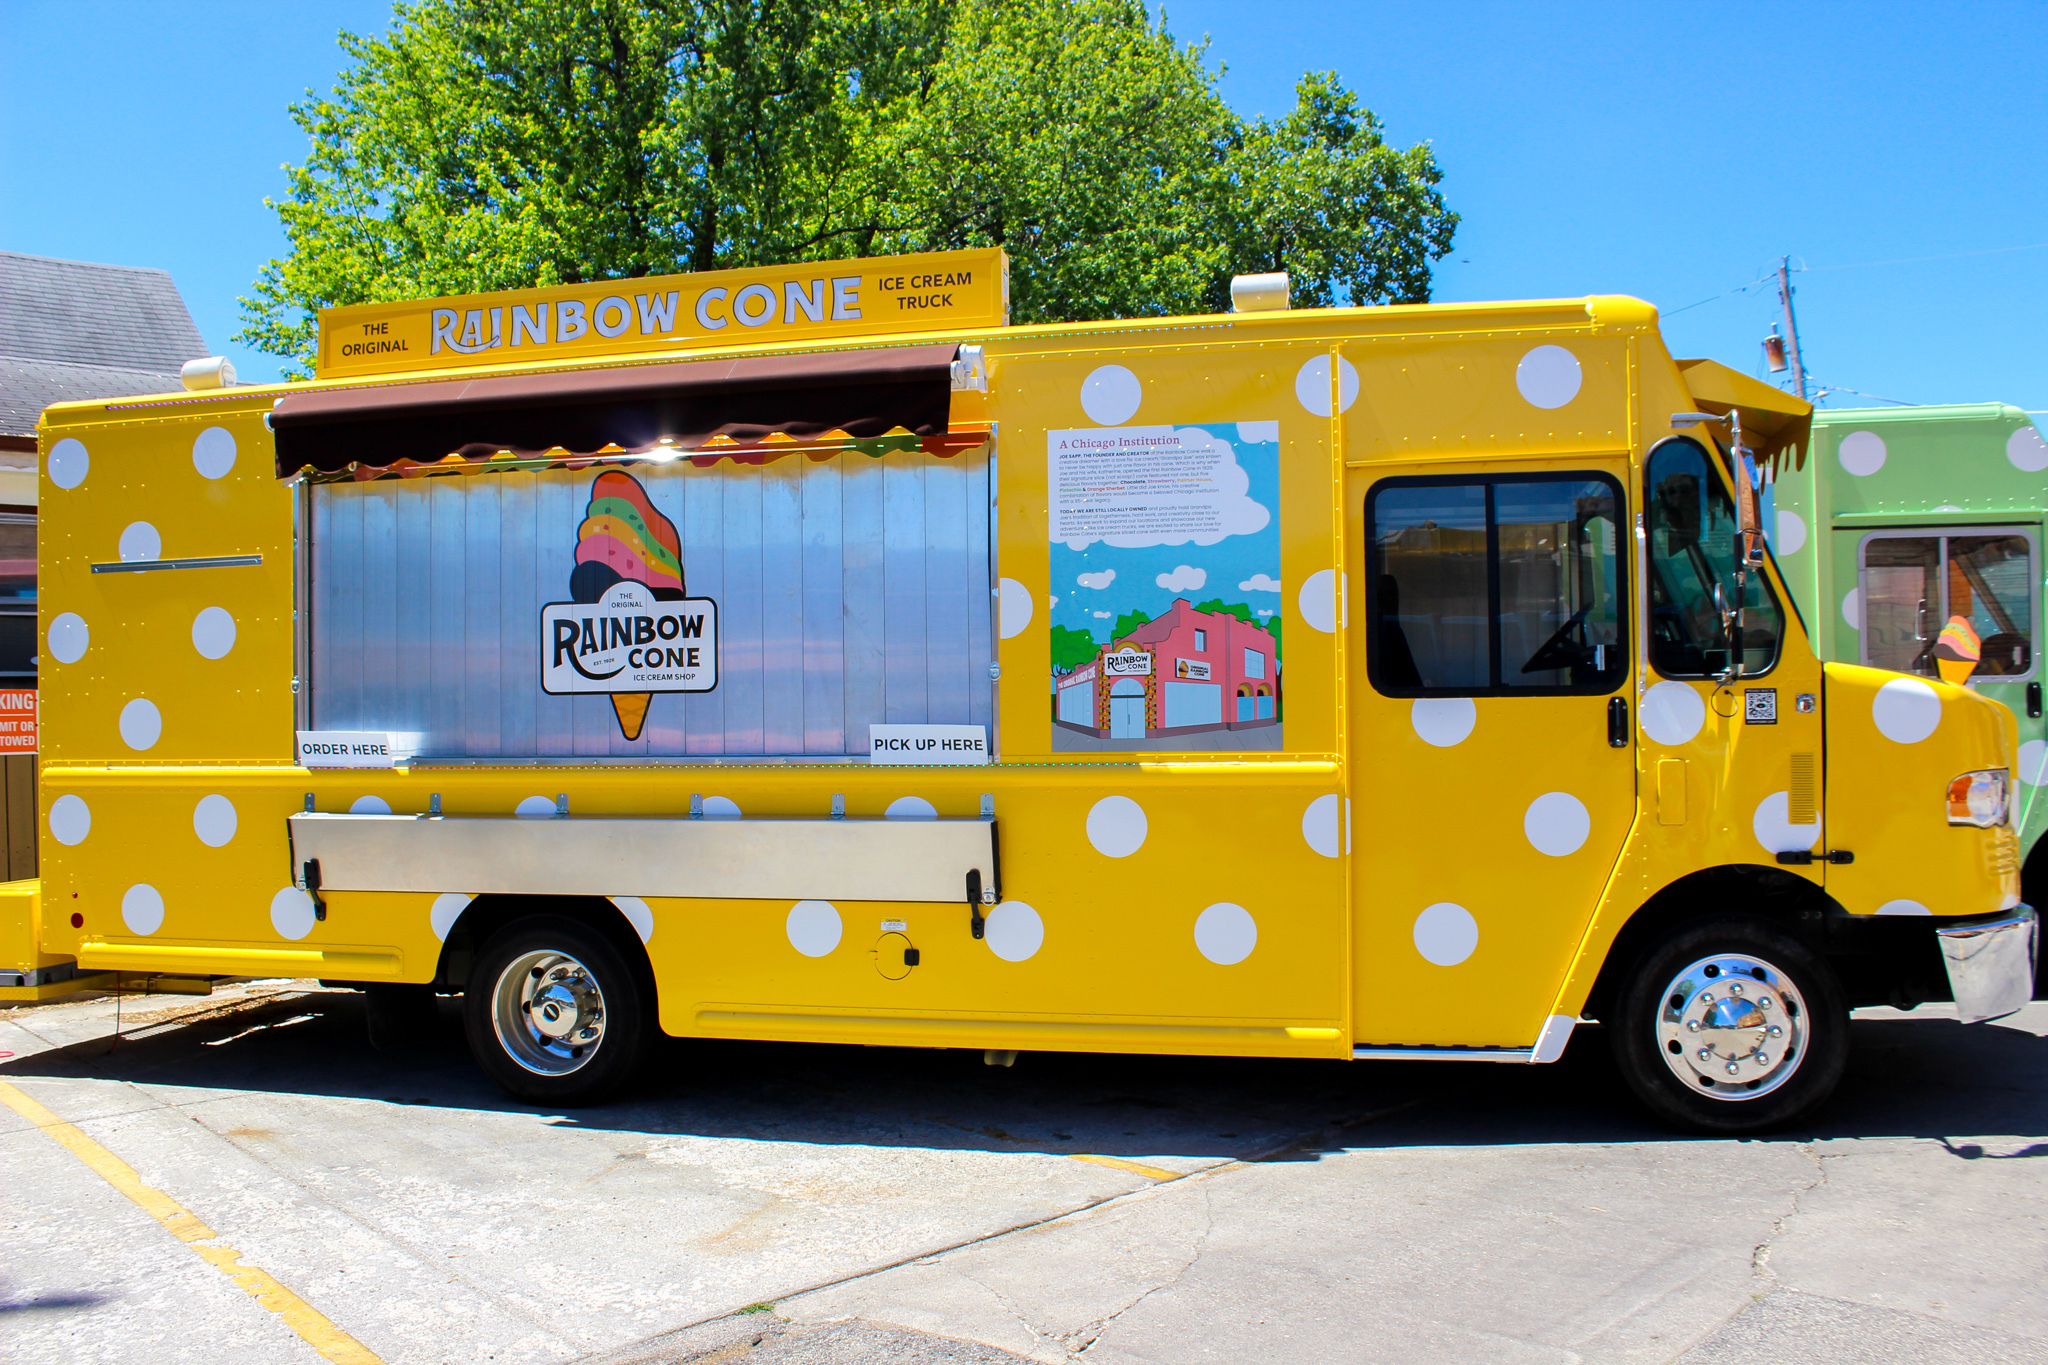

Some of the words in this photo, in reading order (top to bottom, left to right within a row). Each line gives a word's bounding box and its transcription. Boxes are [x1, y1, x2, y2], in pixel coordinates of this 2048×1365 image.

[878, 276, 905, 291] ICE
[910, 271, 972, 289] CREAM
[896, 293, 954, 310] TRUCK
[430, 290, 680, 355] RAINBOW
[694, 275, 863, 331] CONE
[362, 322, 389, 336] THE
[341, 339, 409, 356] ORIGINAL
[1059, 440, 1068, 449] A
[1071, 439, 1116, 450] Chicago
[1118, 436, 1180, 446] Institution
[611, 601, 643, 609] ORIGINAL
[553, 614, 704, 680] RAINBOW
[628, 647, 701, 669] CONE
[1107, 655, 1148, 672] RAINBOW
[0, 693, 34, 710] KING
[20, 721, 35, 732] OR
[0, 735, 35, 746] TOWED
[874, 738, 911, 751] PICK
[915, 738, 937, 751] UP
[941, 738, 984, 751] HERE
[302, 743, 349, 755] ORDER
[352, 744, 389, 756] HERE
